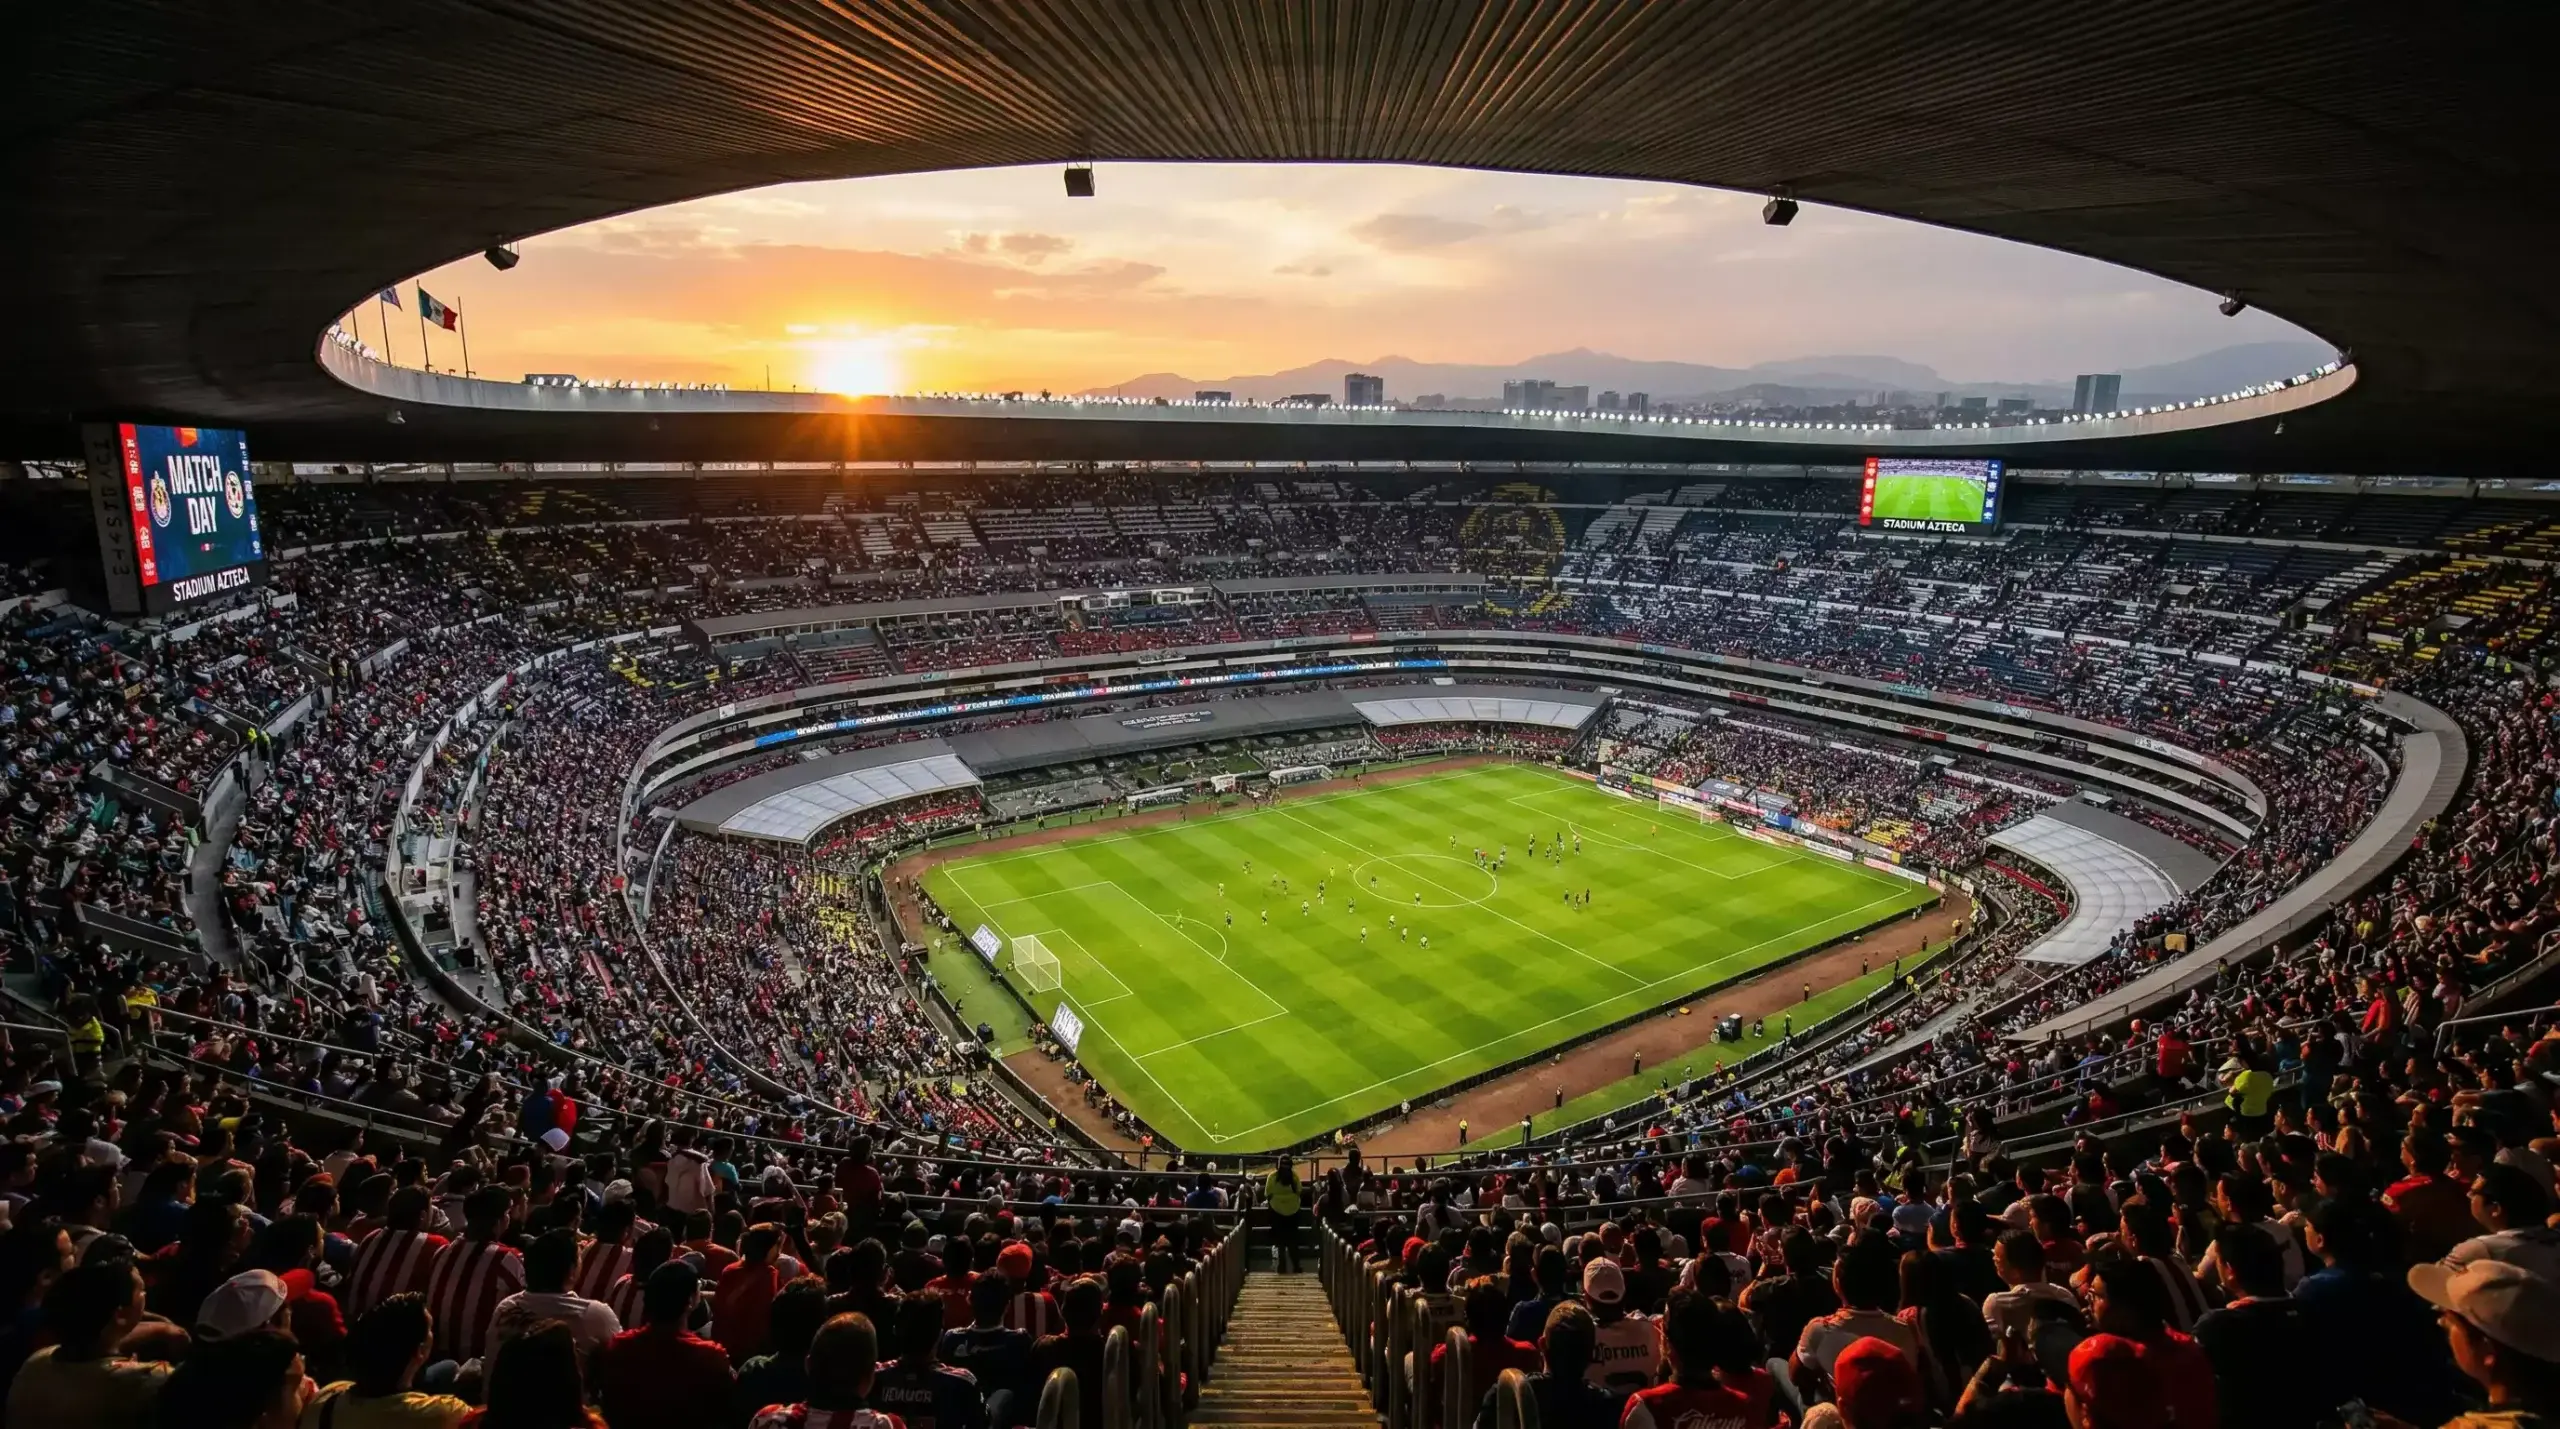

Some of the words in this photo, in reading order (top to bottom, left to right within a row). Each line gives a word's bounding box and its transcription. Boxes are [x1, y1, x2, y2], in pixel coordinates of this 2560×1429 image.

[167, 455, 223, 494] MATCH
[187, 496, 217, 535] DAY
[1883, 519, 1925, 530] STADIUM
[1927, 521, 1965, 533] AZTECA
[173, 574, 216, 602] STADIUM
[217, 566, 250, 591] AZTECA
[1593, 1342, 1649, 1366] Corona
